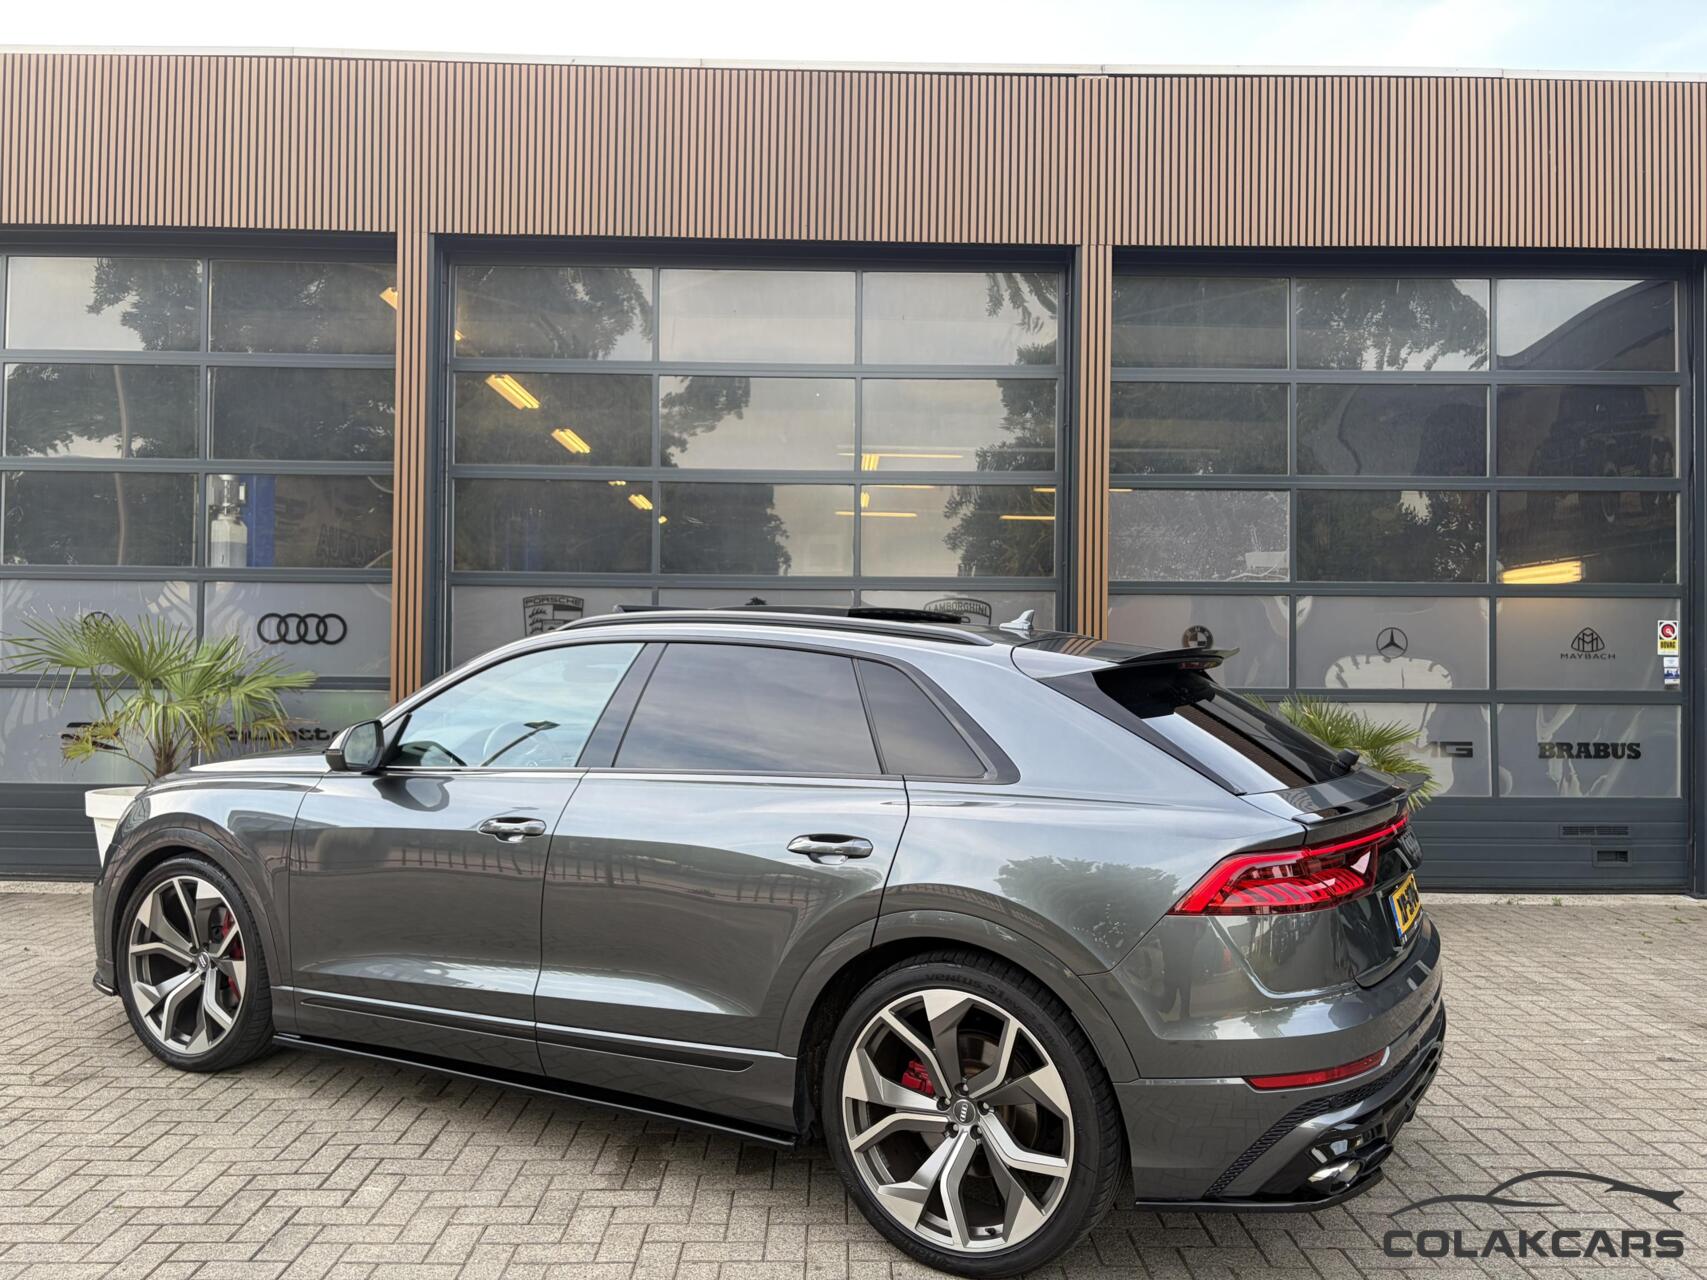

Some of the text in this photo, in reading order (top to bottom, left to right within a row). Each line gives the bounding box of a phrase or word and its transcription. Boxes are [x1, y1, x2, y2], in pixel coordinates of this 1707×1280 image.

[524, 596, 582, 606] PORSCHE
[928, 601, 988, 616] LAMBORGHINI
[1660, 640, 1676, 649] BOVAG
[1560, 652, 1616, 660] MAYBACH
[1538, 742, 1641, 760] BRABUS
